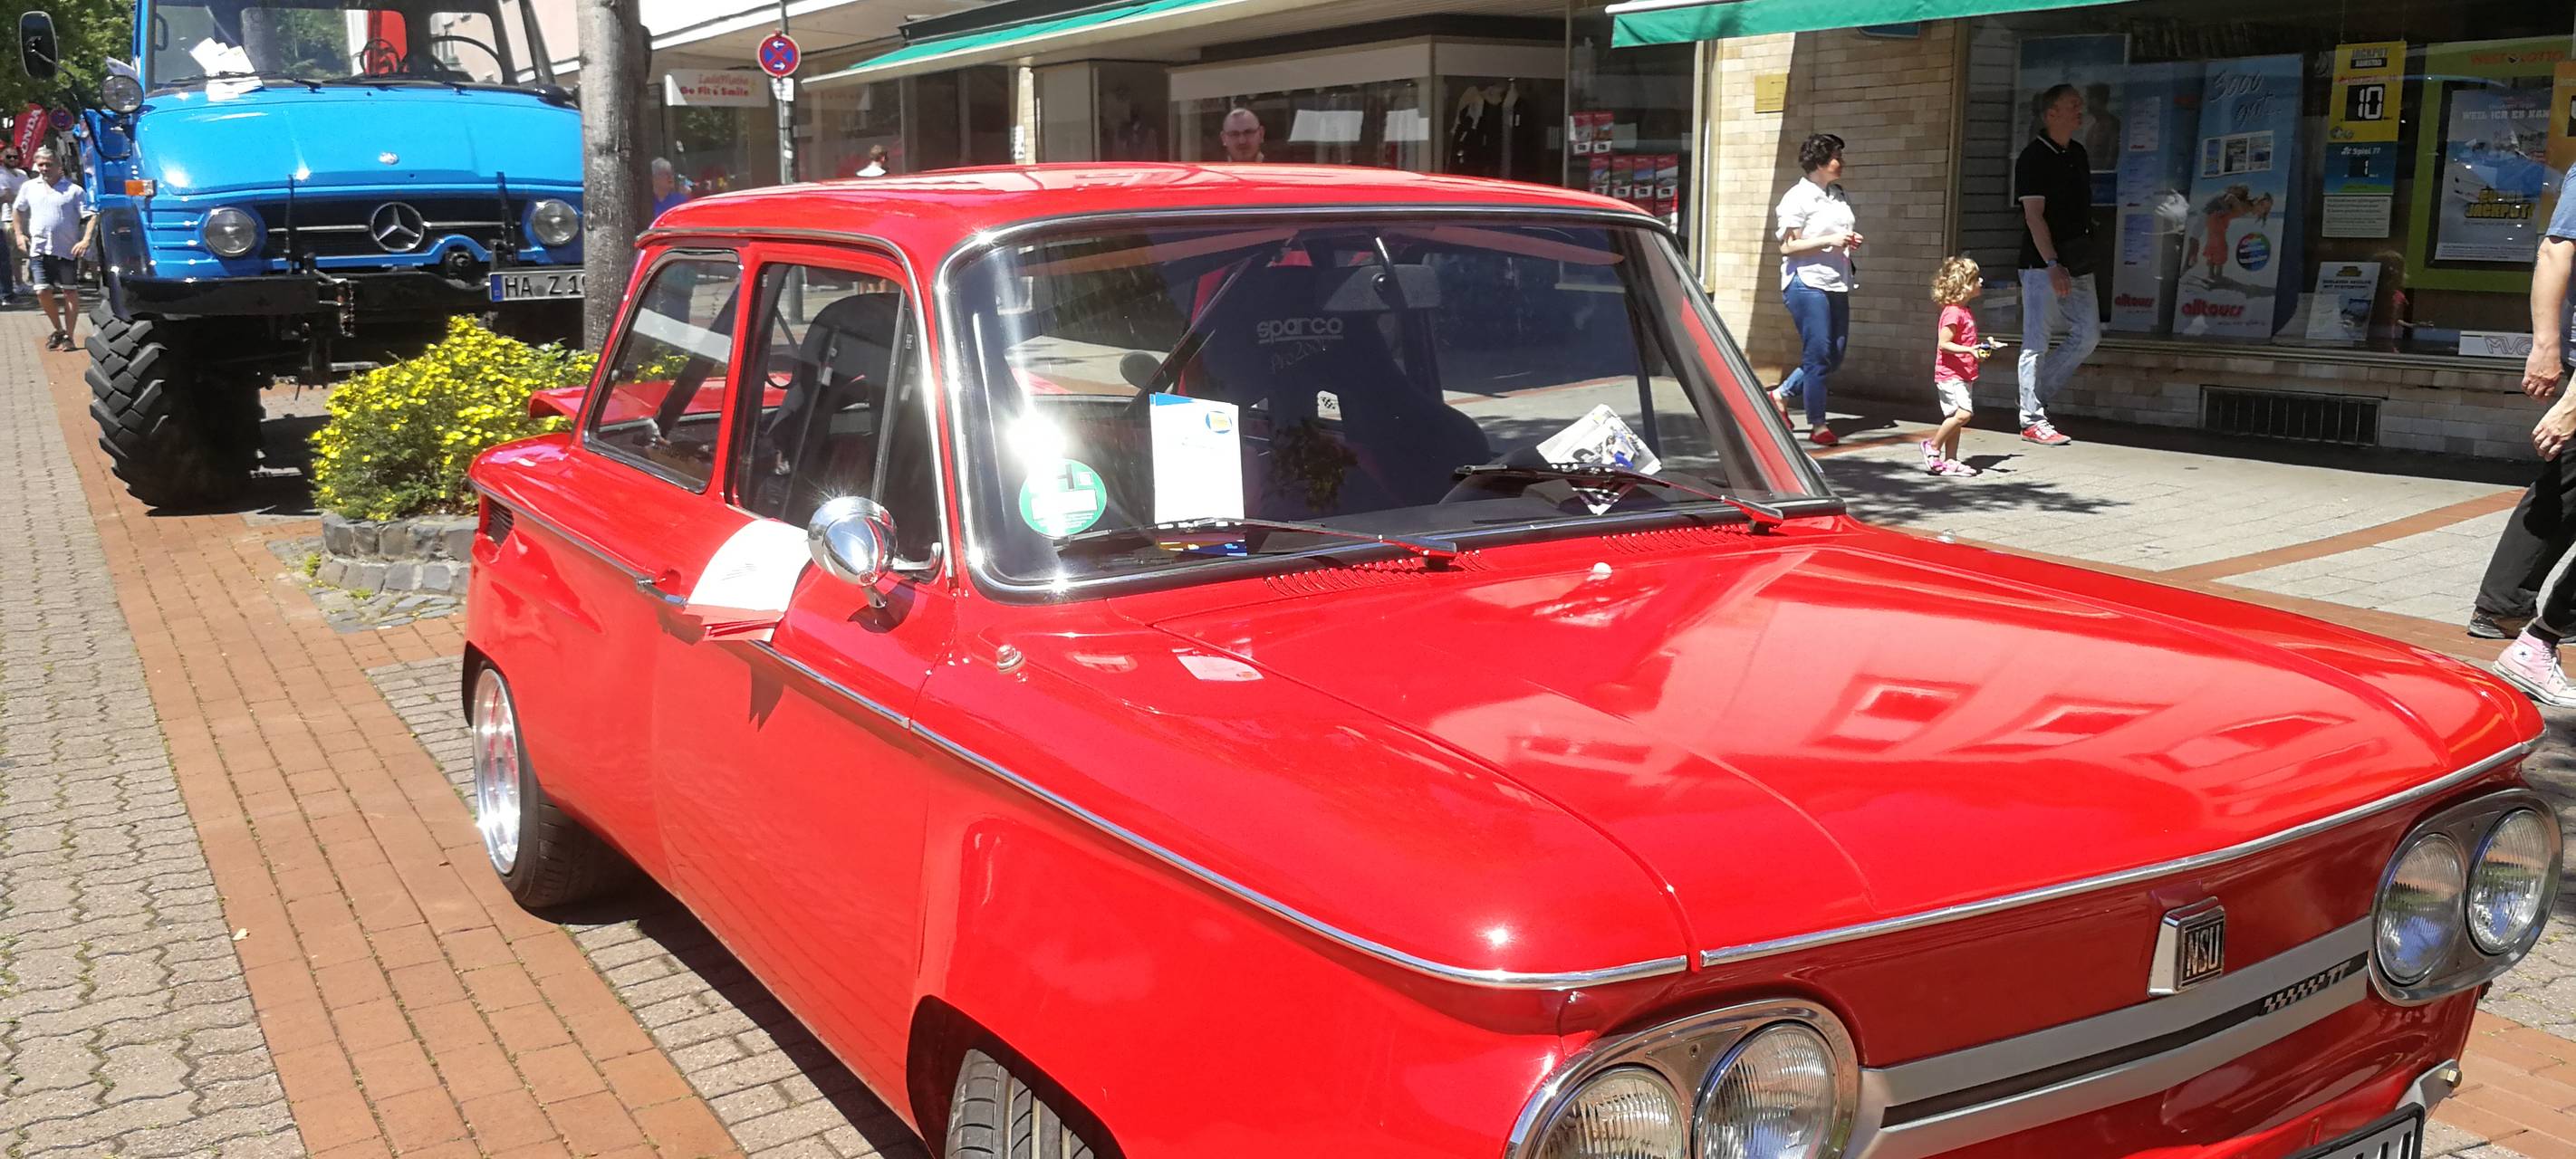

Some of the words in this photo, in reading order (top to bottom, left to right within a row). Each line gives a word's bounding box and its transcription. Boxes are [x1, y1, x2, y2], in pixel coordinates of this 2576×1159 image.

[2358, 85, 2384, 120] 10
[505, 276, 533, 297] HA
[548, 275, 562, 295] Z
[2114, 293, 2155, 308] alltours
[2181, 298, 2245, 318] alltours
[1256, 317, 1343, 344] sparco
[2187, 924, 2220, 978] NSU
[2328, 962, 2350, 985] TT
